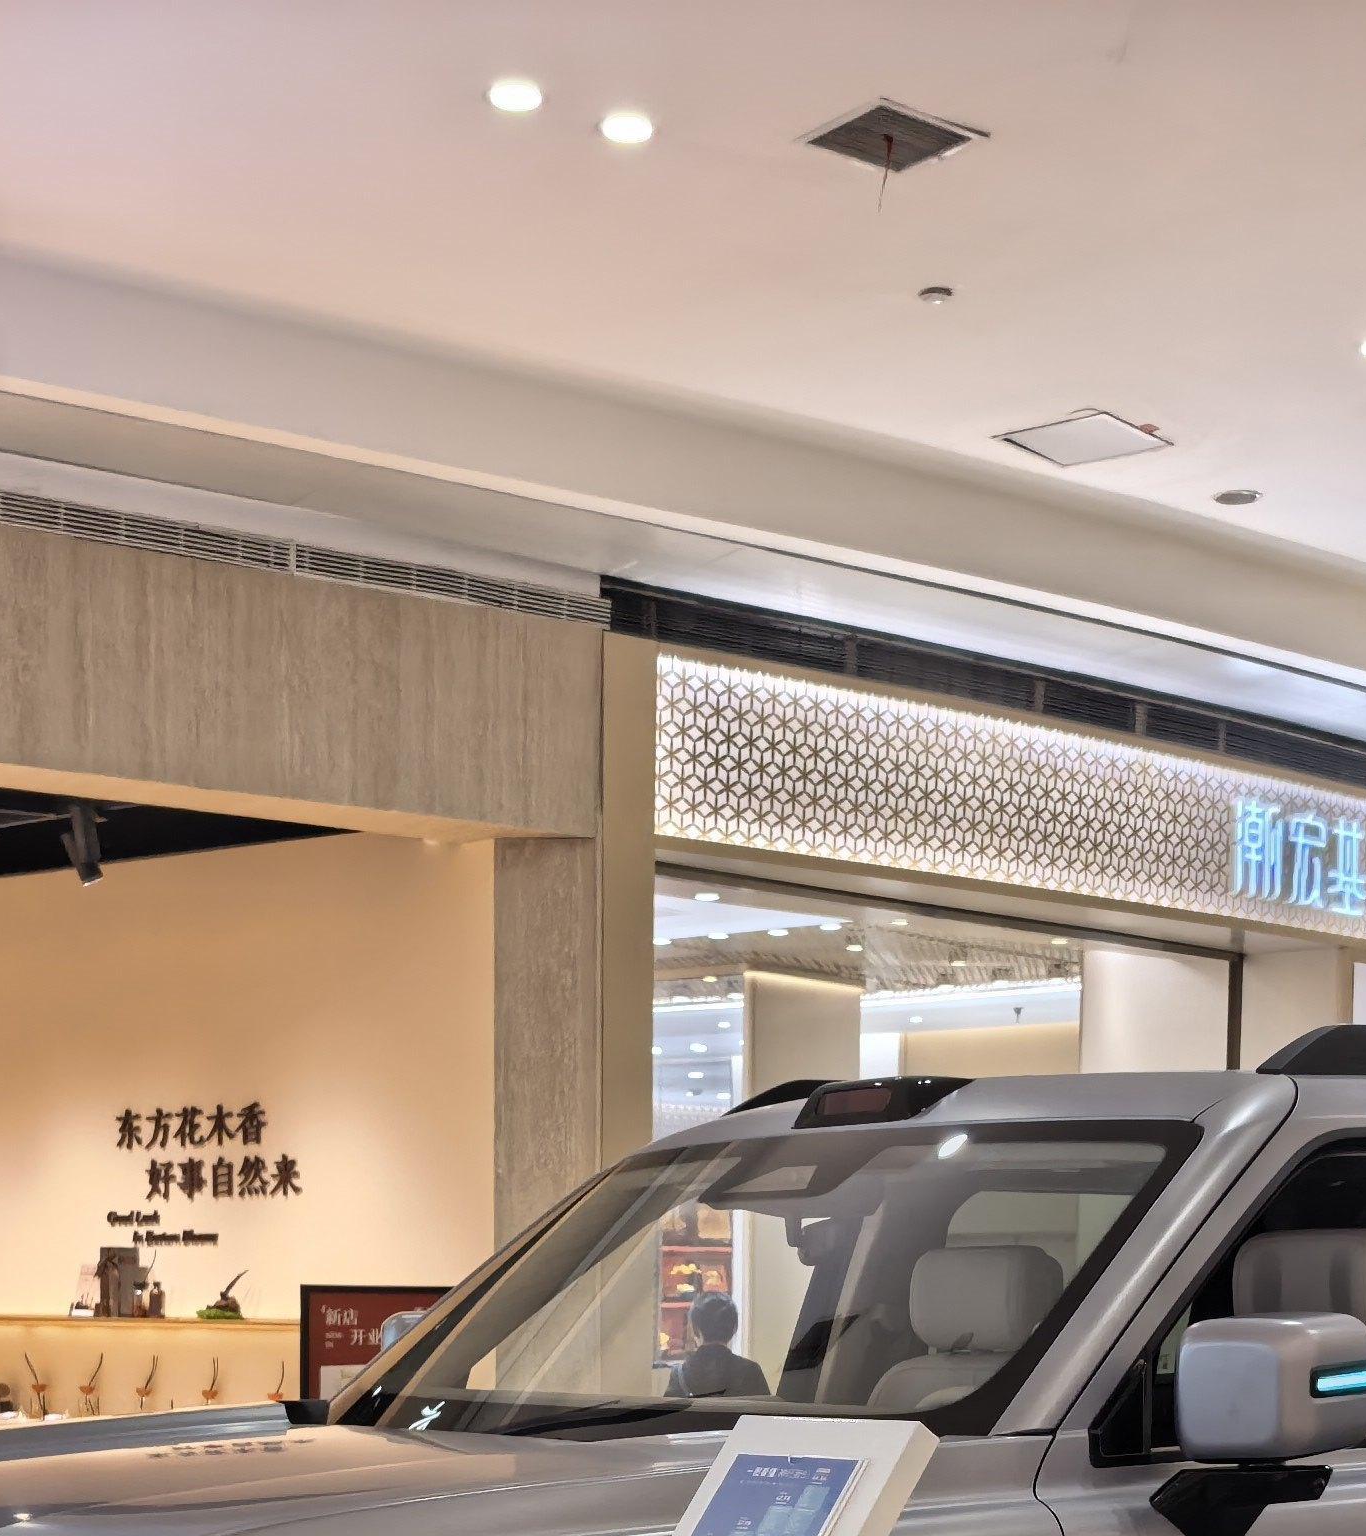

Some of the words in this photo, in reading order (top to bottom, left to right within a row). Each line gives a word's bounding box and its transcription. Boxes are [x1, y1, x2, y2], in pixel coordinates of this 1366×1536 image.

[115, 1101, 268, 1151] 东方花木香
[144, 1153, 304, 1203] 好事自然来
